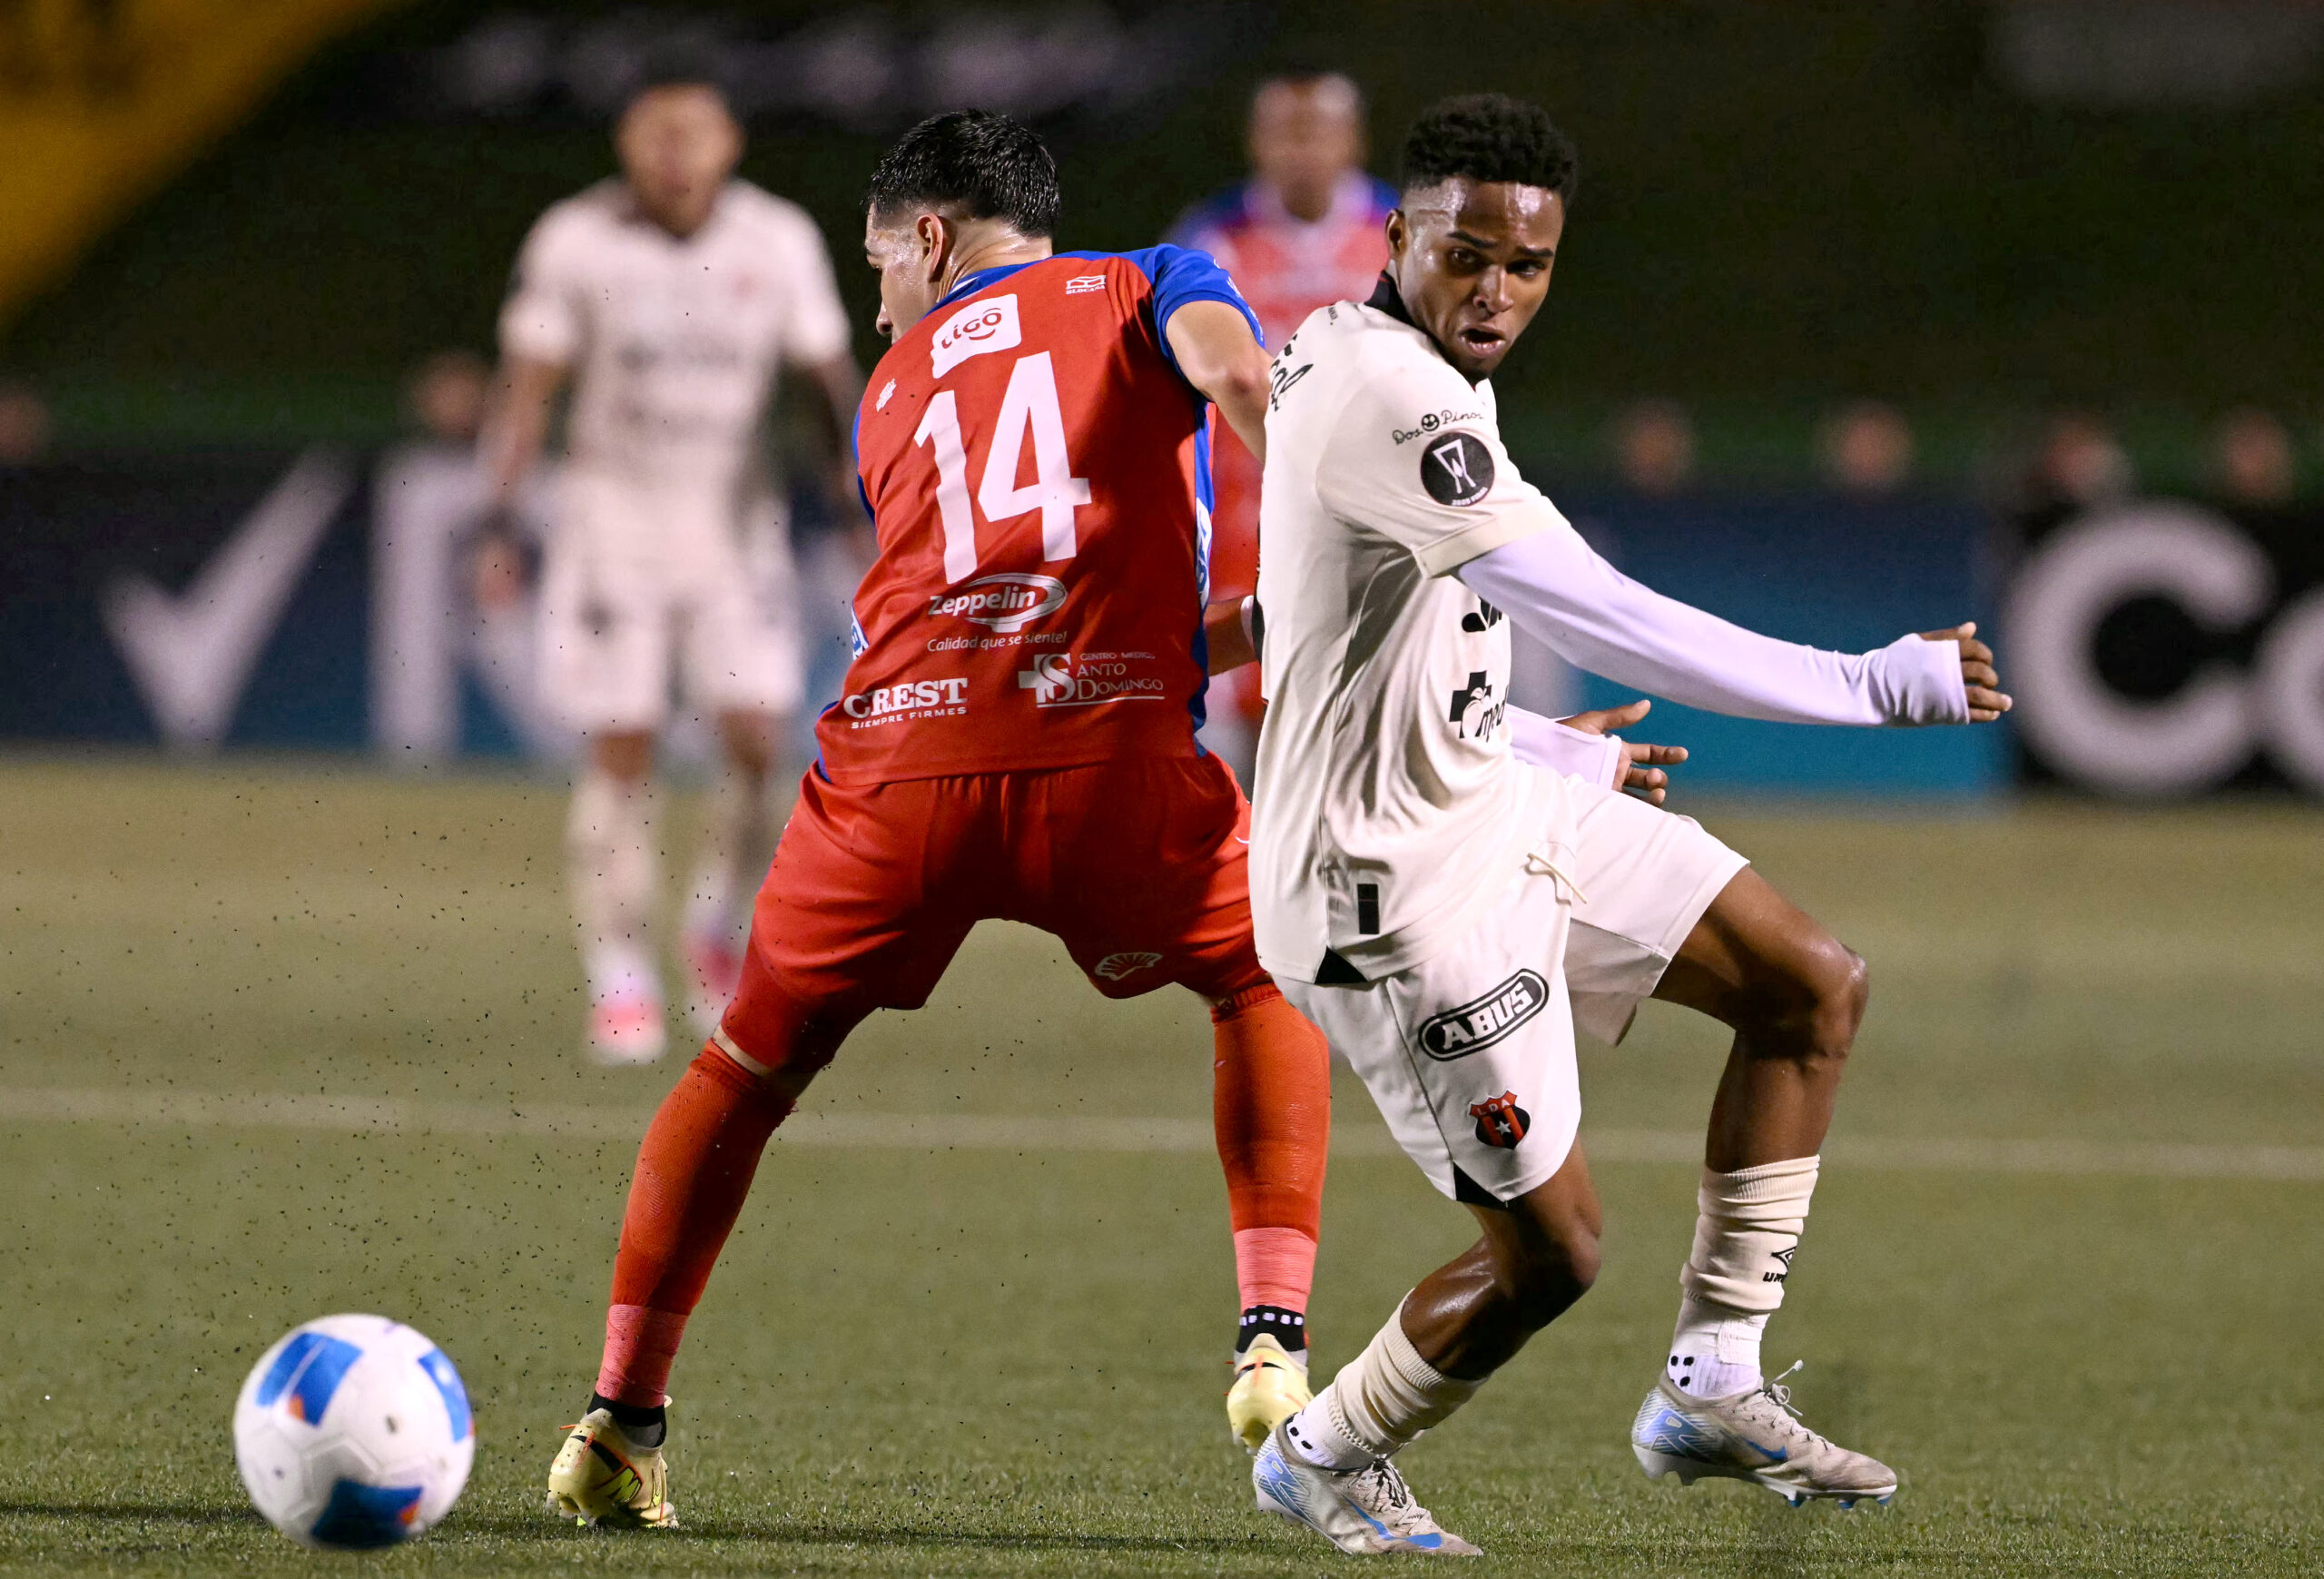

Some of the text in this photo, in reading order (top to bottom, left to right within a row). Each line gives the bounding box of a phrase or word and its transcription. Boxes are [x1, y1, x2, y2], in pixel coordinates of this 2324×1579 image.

[1392, 428, 1423, 446] Dos
[914, 351, 1093, 585] 14
[928, 586, 1037, 617] Zeppelin
[927, 635, 979, 652] Calidad
[980, 637, 1006, 651] que
[1007, 636, 1022, 646] se
[1078, 652, 1118, 662] CENTRO
[843, 677, 969, 719] CREST
[1077, 678, 1165, 700] DOMINGO
[851, 706, 968, 730] SIEMPRE FIRMES
[1441, 981, 1534, 1051] ABUS
[1476, 1098, 1512, 1116] LDA
